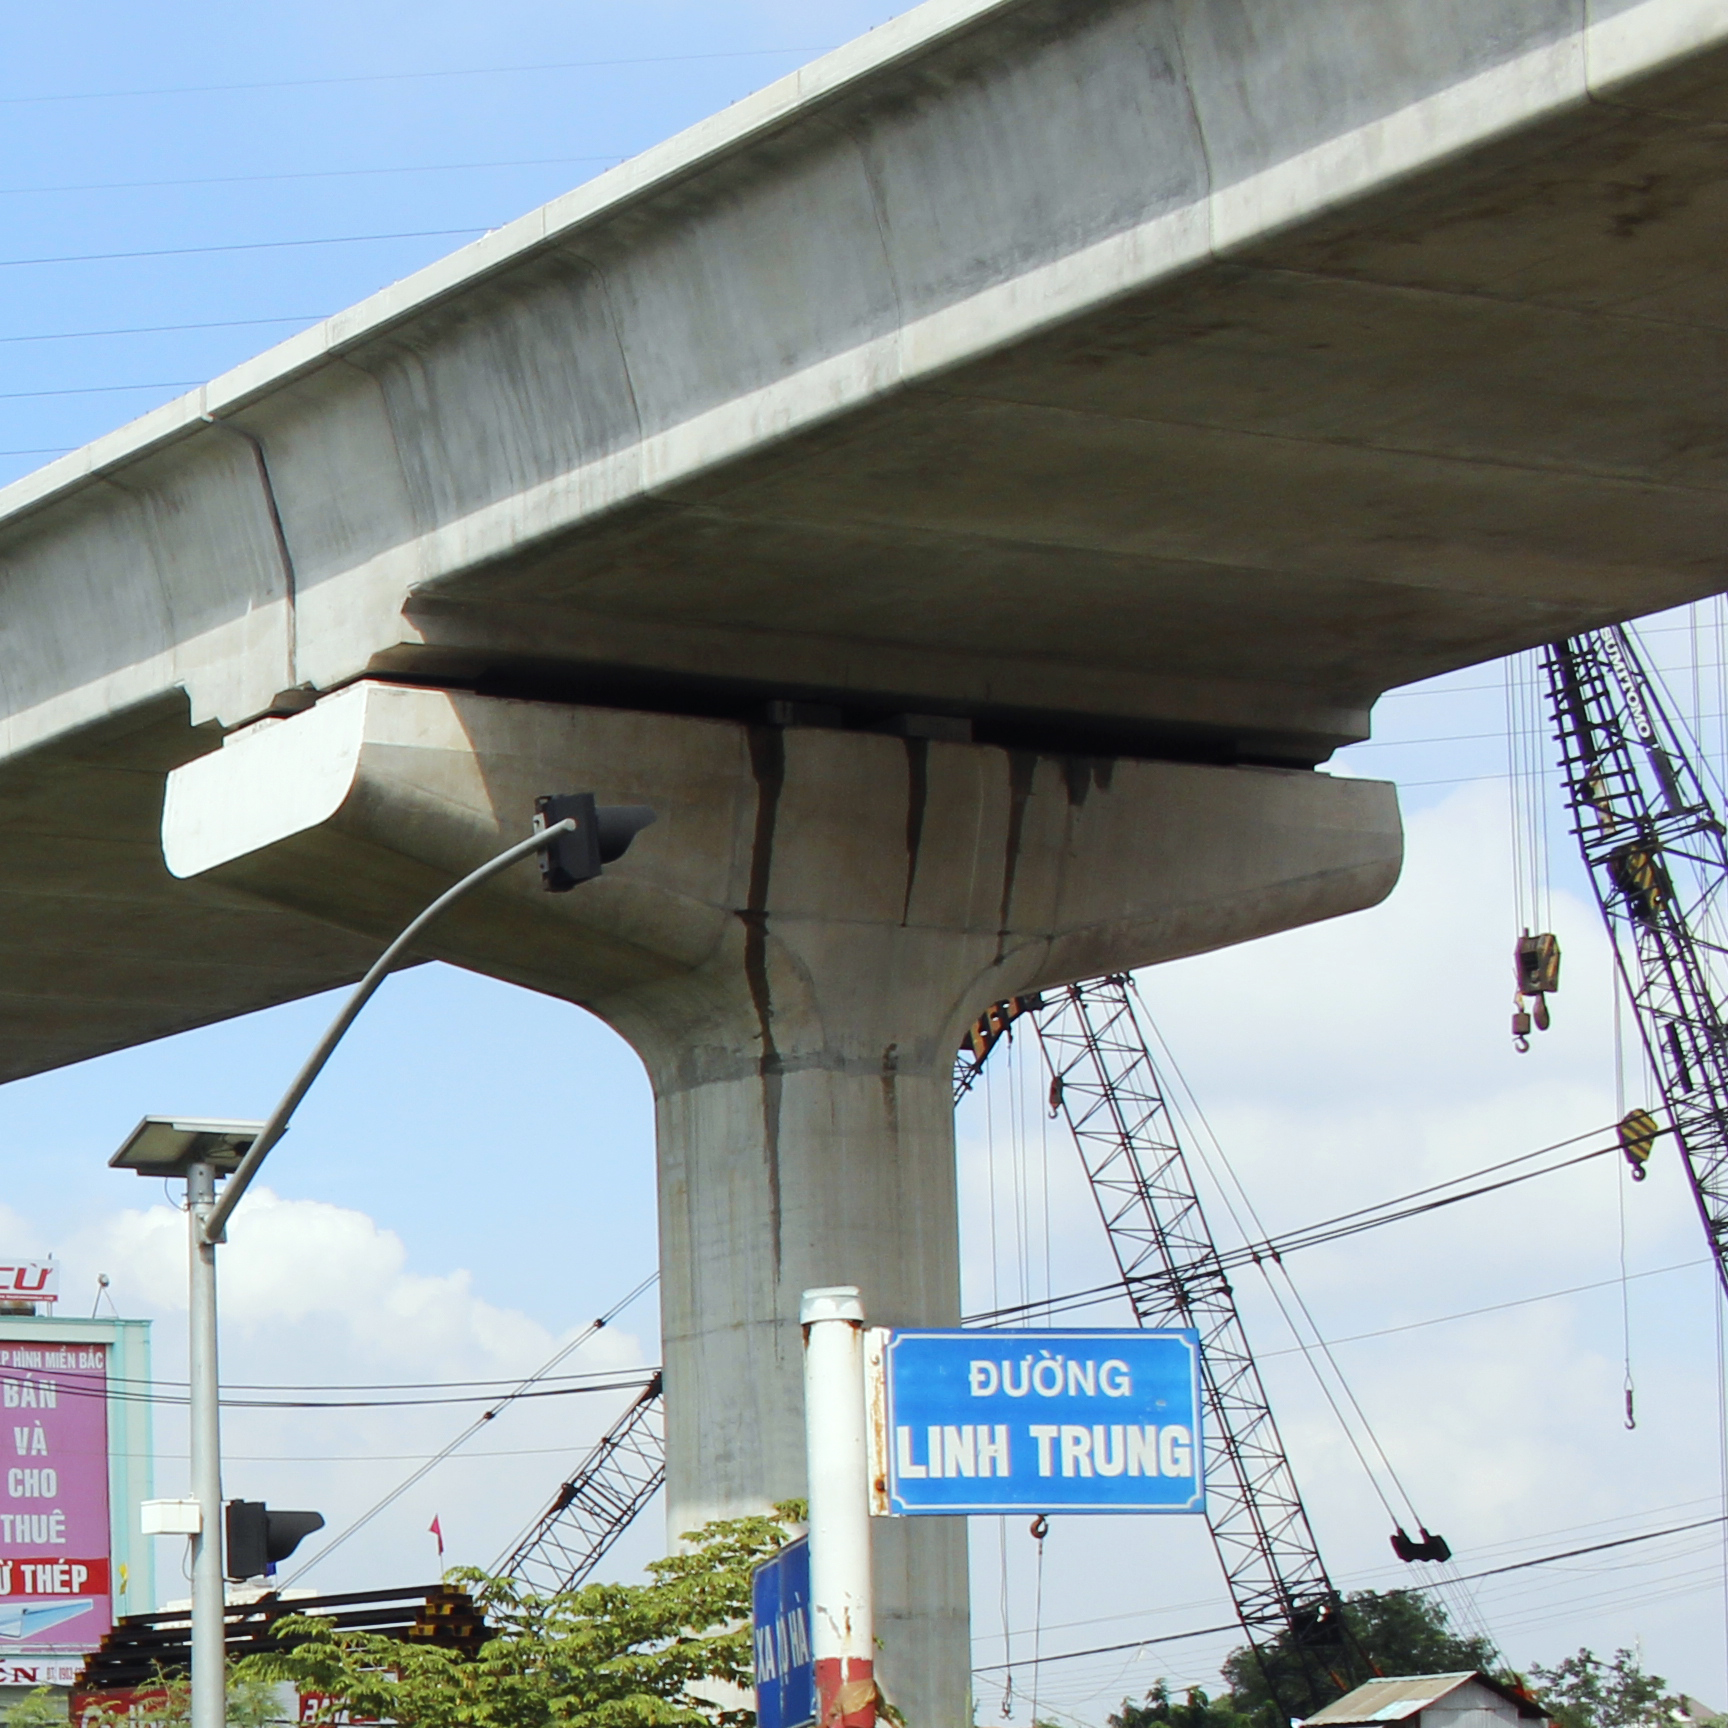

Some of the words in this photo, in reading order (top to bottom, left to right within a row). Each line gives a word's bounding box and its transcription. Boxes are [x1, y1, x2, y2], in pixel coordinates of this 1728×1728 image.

[1599, 626, 1651, 738] SUMITOMO
[12, 1347, 42, 1368] HÌNH
[45, 1345, 77, 1369] MIỀN
[79, 1345, 104, 1369] BẮC
[969, 1349, 1131, 1398] ĐƯỜNG
[3, 1373, 57, 1408] BÁN
[14, 1420, 47, 1456] VÀ
[897, 1424, 1010, 1479] LINH
[1030, 1424, 1191, 1479] TRUNG
[8, 1468, 57, 1498] CHO
[0, 1508, 66, 1544] THUÊ
[20, 1558, 88, 1594] THÉP
[755, 1625, 776, 1684] XA
